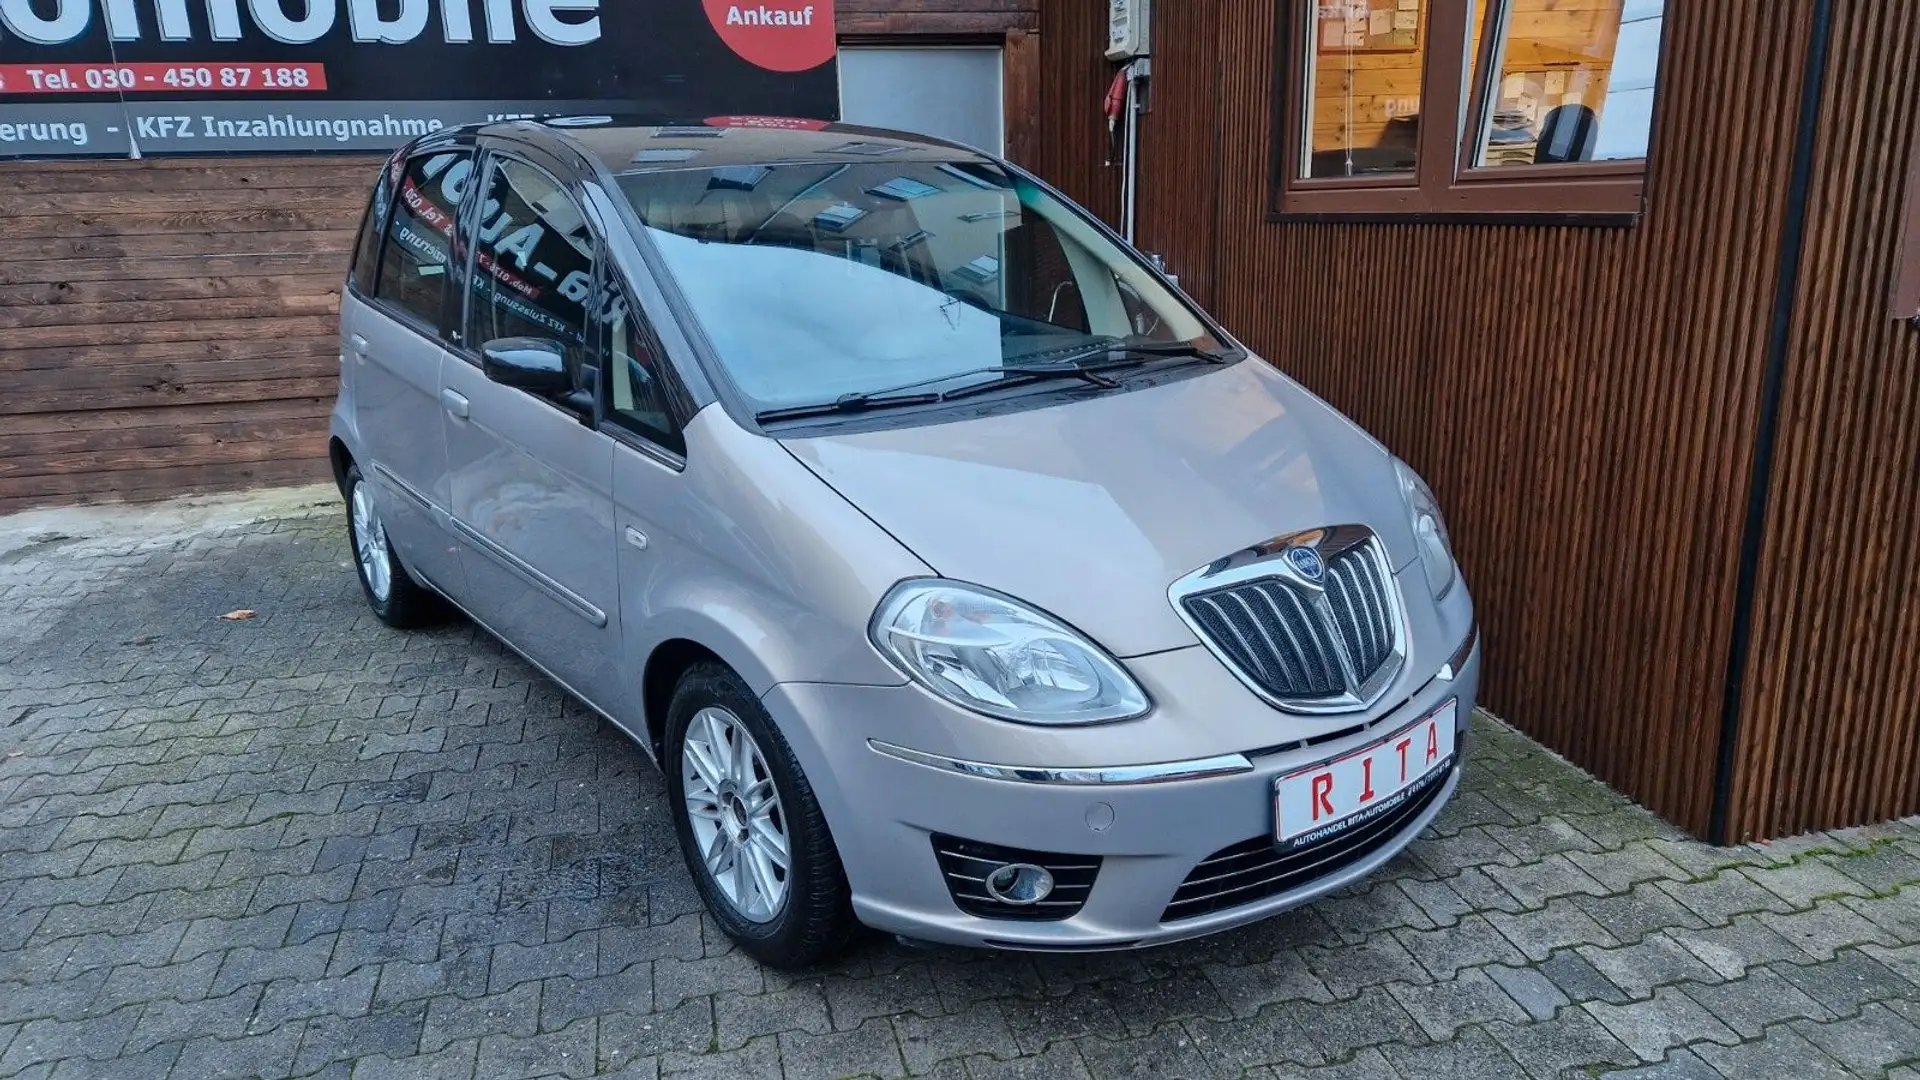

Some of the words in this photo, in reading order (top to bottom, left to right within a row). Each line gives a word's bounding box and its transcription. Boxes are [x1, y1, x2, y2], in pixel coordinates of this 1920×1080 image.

[726, 5, 814, 25] Ankauf
[26, 69, 77, 90] Tel.
[85, 68, 135, 89] 030
[163, 68, 212, 88] 450
[219, 68, 251, 88] 87
[262, 67, 309, 88] 188
[136, 116, 195, 138] KFZ
[201, 114, 443, 142] Inzahlungnahme
[1293, 821, 1347, 848] AUTOHANDEL
